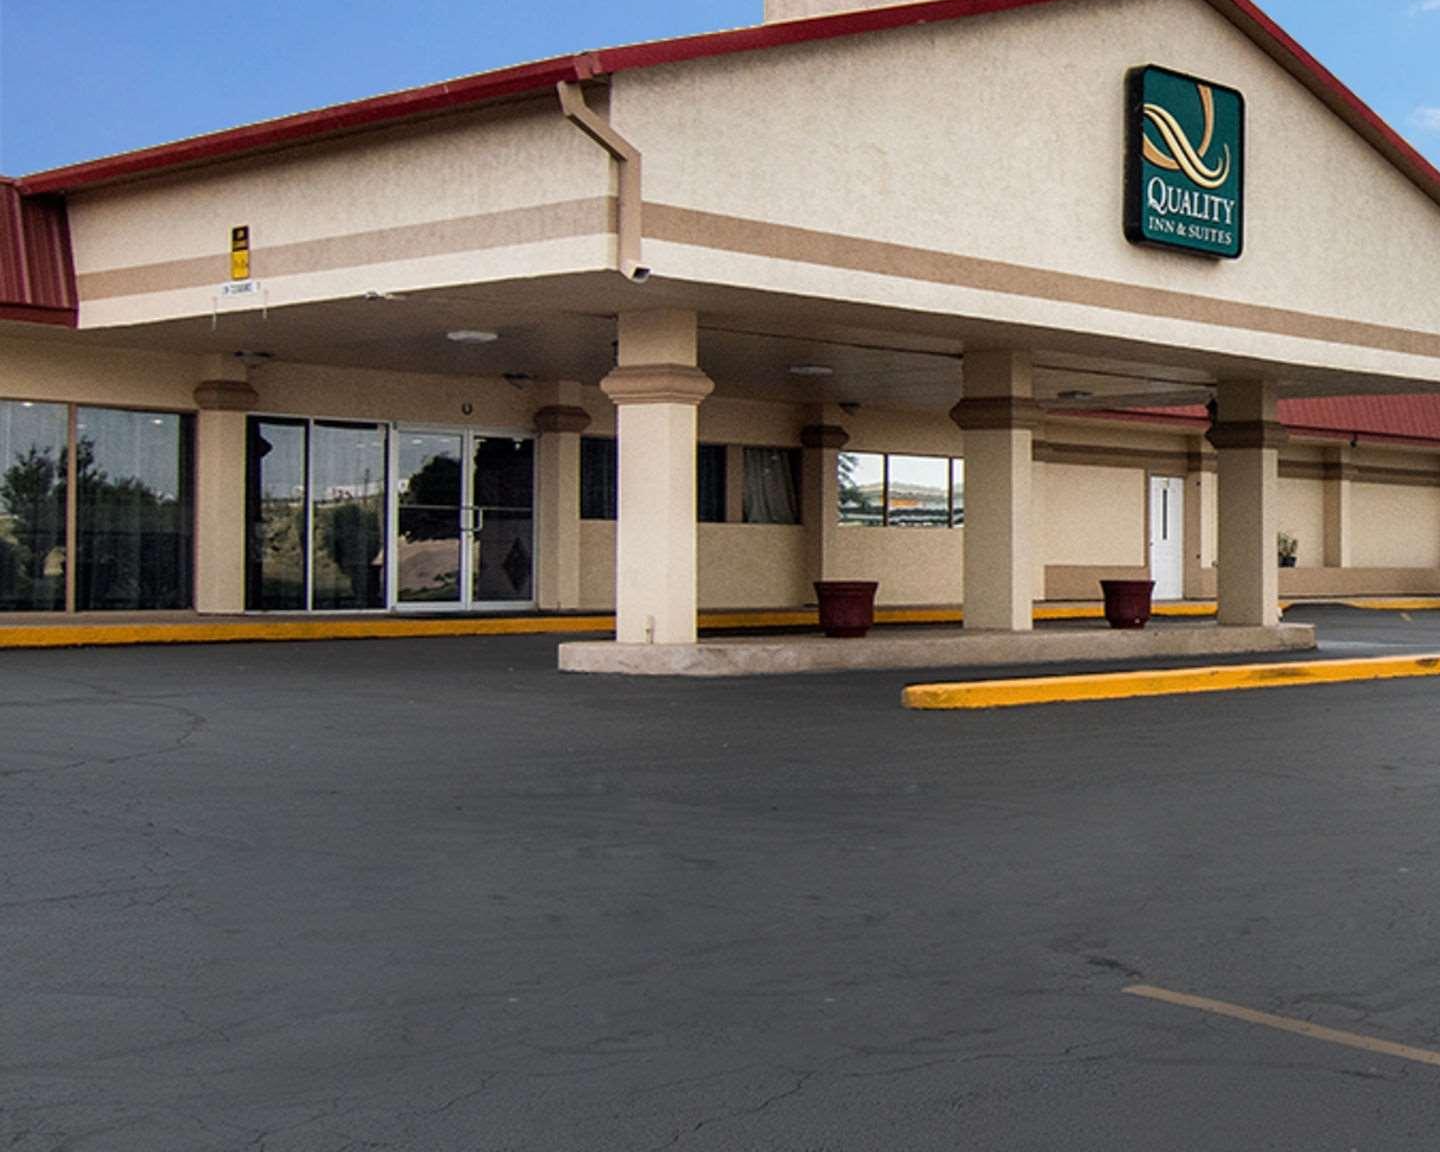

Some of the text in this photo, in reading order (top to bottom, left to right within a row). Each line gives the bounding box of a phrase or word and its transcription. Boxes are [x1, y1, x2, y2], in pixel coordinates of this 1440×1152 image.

[1147, 176, 1235, 225] QUALITY
[1149, 216, 1232, 245] INN & SUITES
